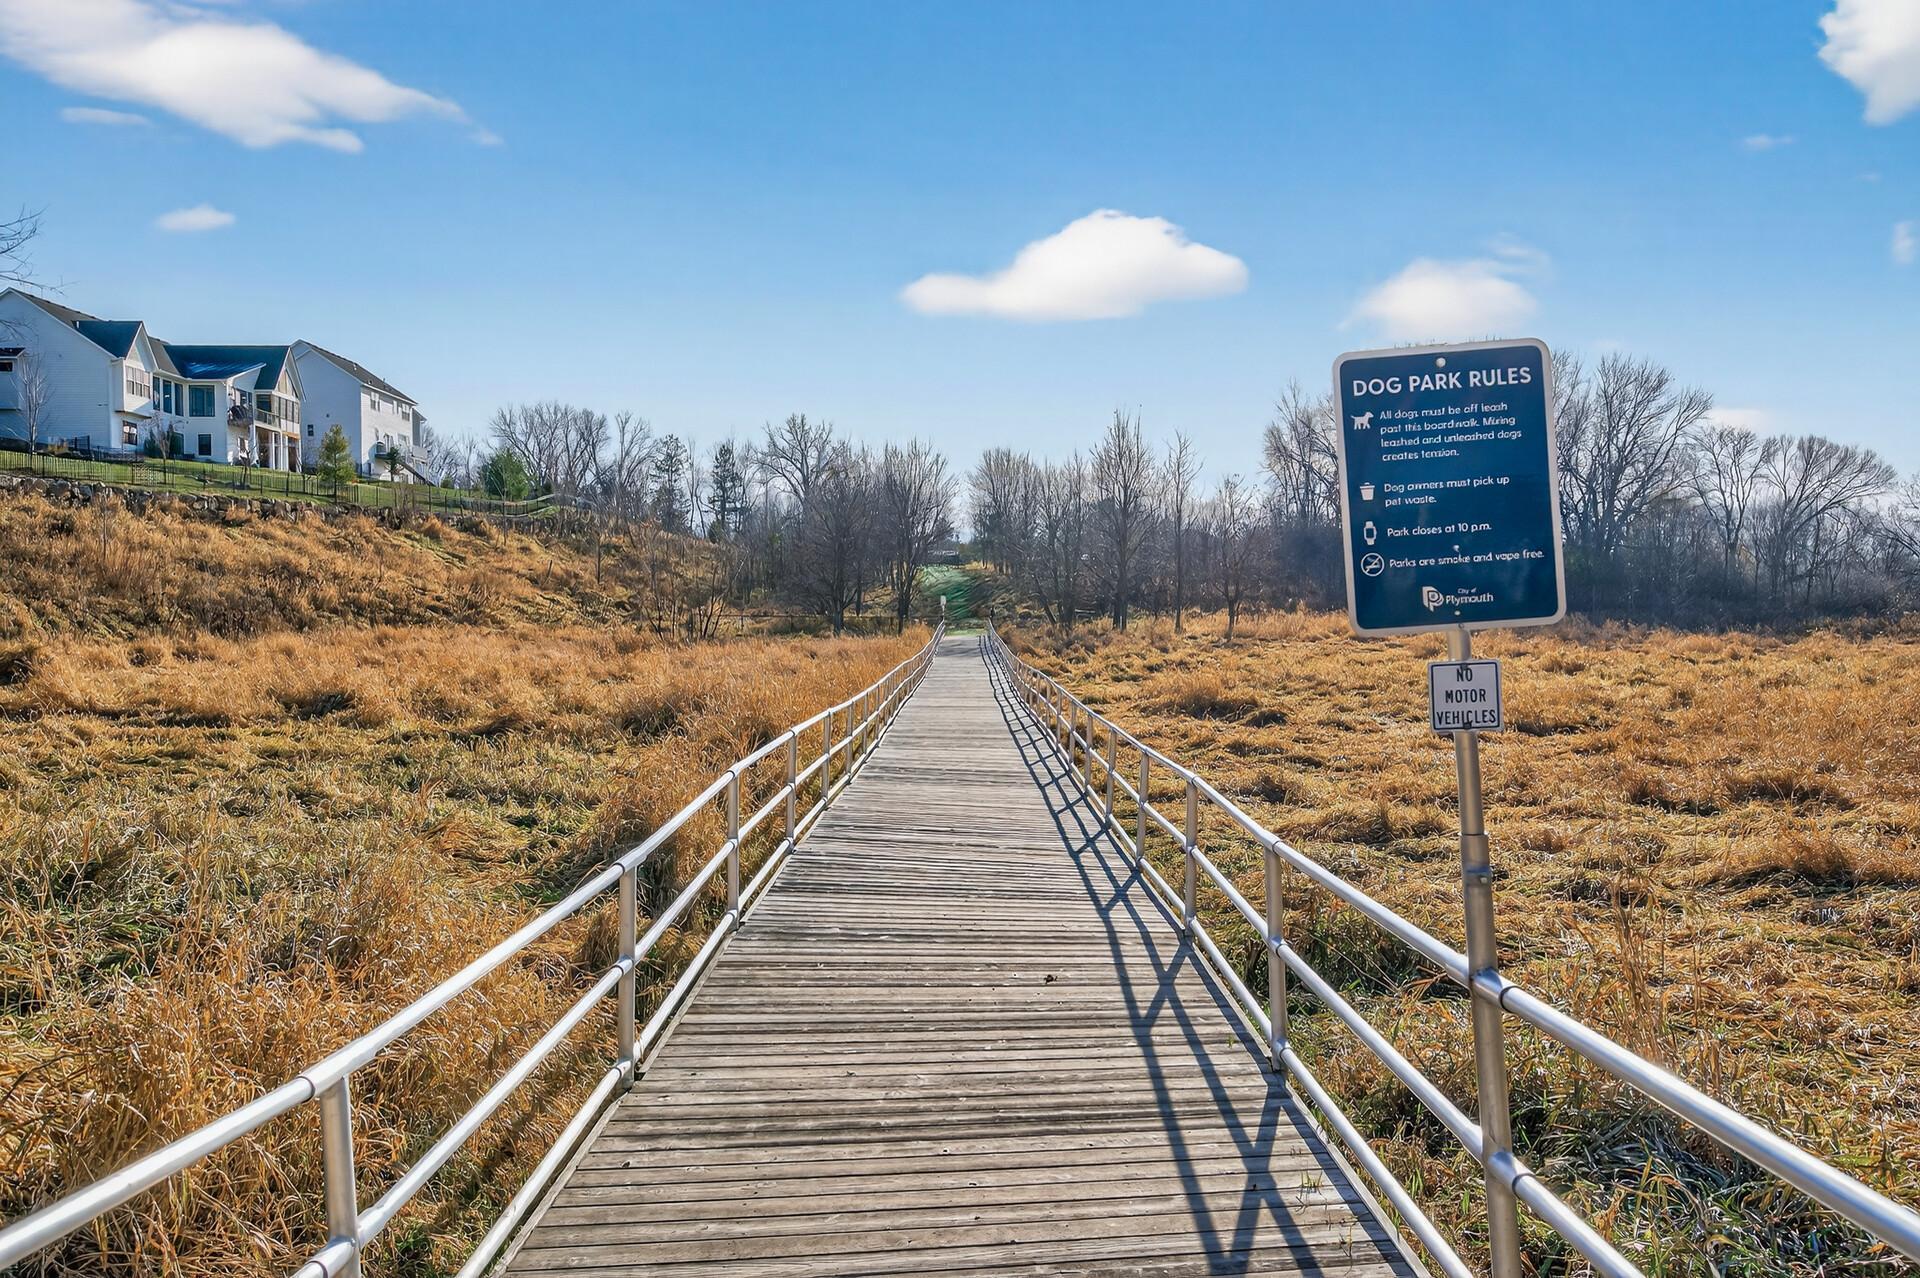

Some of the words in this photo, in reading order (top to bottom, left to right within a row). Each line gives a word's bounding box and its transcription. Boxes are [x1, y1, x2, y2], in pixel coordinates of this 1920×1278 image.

[1353, 378, 1402, 396] DOG
[1409, 372, 1462, 392] PARK
[1469, 367, 1532, 387] RULES
[1380, 410, 1392, 419] All
[1394, 410, 1418, 420] dogs
[1422, 407, 1445, 417] must
[1449, 406, 1461, 415] be
[1464, 404, 1478, 413] off
[1481, 402, 1507, 412] leash
[1380, 425, 1401, 435] past
[1405, 422, 1422, 432] this
[1381, 436, 1419, 447] leashed
[1423, 435, 1441, 444] and
[1444, 431, 1494, 443] unleashed
[1497, 429, 1522, 440] dogs
[1382, 451, 1419, 461] creates
[1422, 448, 1459, 459] tension.
[1384, 483, 1404, 493] Dog
[1447, 479, 1470, 488] must
[1473, 476, 1494, 487] pick
[1497, 476, 1510, 486] up
[1385, 497, 1401, 508] pet
[1405, 495, 1437, 505] waste.
[1387, 527, 1409, 537] Park
[1412, 525, 1442, 535] closes
[1445, 524, 1455, 533] at
[1458, 523, 1468, 532] 10
[1471, 523, 1492, 533] p.m.
[1389, 558, 1416, 568] Parks
[1419, 557, 1435, 566] are
[1438, 554, 1471, 565] smoke
[1473, 552, 1492, 562] and
[1495, 551, 1520, 561] vape
[1522, 549, 1545, 559] free.
[1446, 592, 1494, 606] Plymouth
[1456, 668, 1473, 682] NO
[1445, 689, 1486, 703] MOTOR
[1436, 709, 1496, 725] VEHICLES
